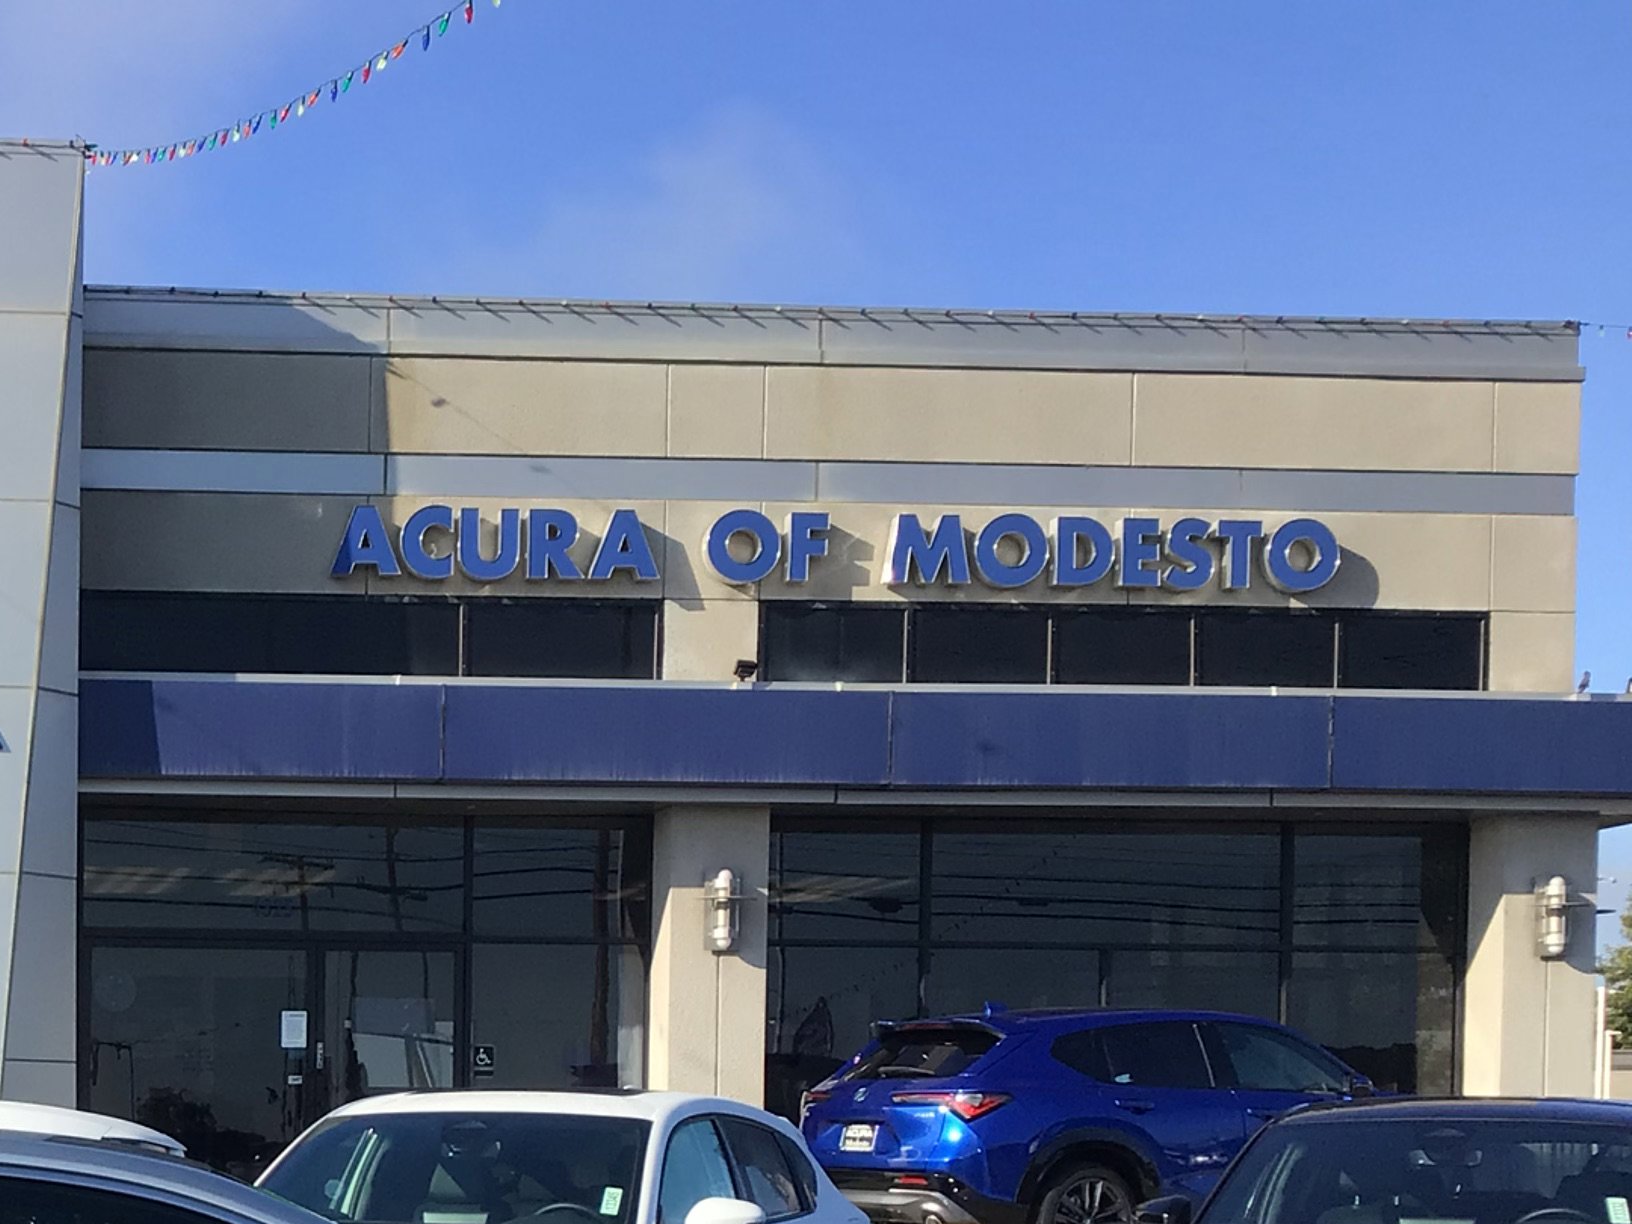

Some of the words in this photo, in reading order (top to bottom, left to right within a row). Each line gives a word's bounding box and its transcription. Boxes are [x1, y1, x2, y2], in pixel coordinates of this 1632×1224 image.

[331, 504, 661, 582] ACURA
[703, 508, 830, 586] OF
[880, 512, 1342, 593] MODESTO
